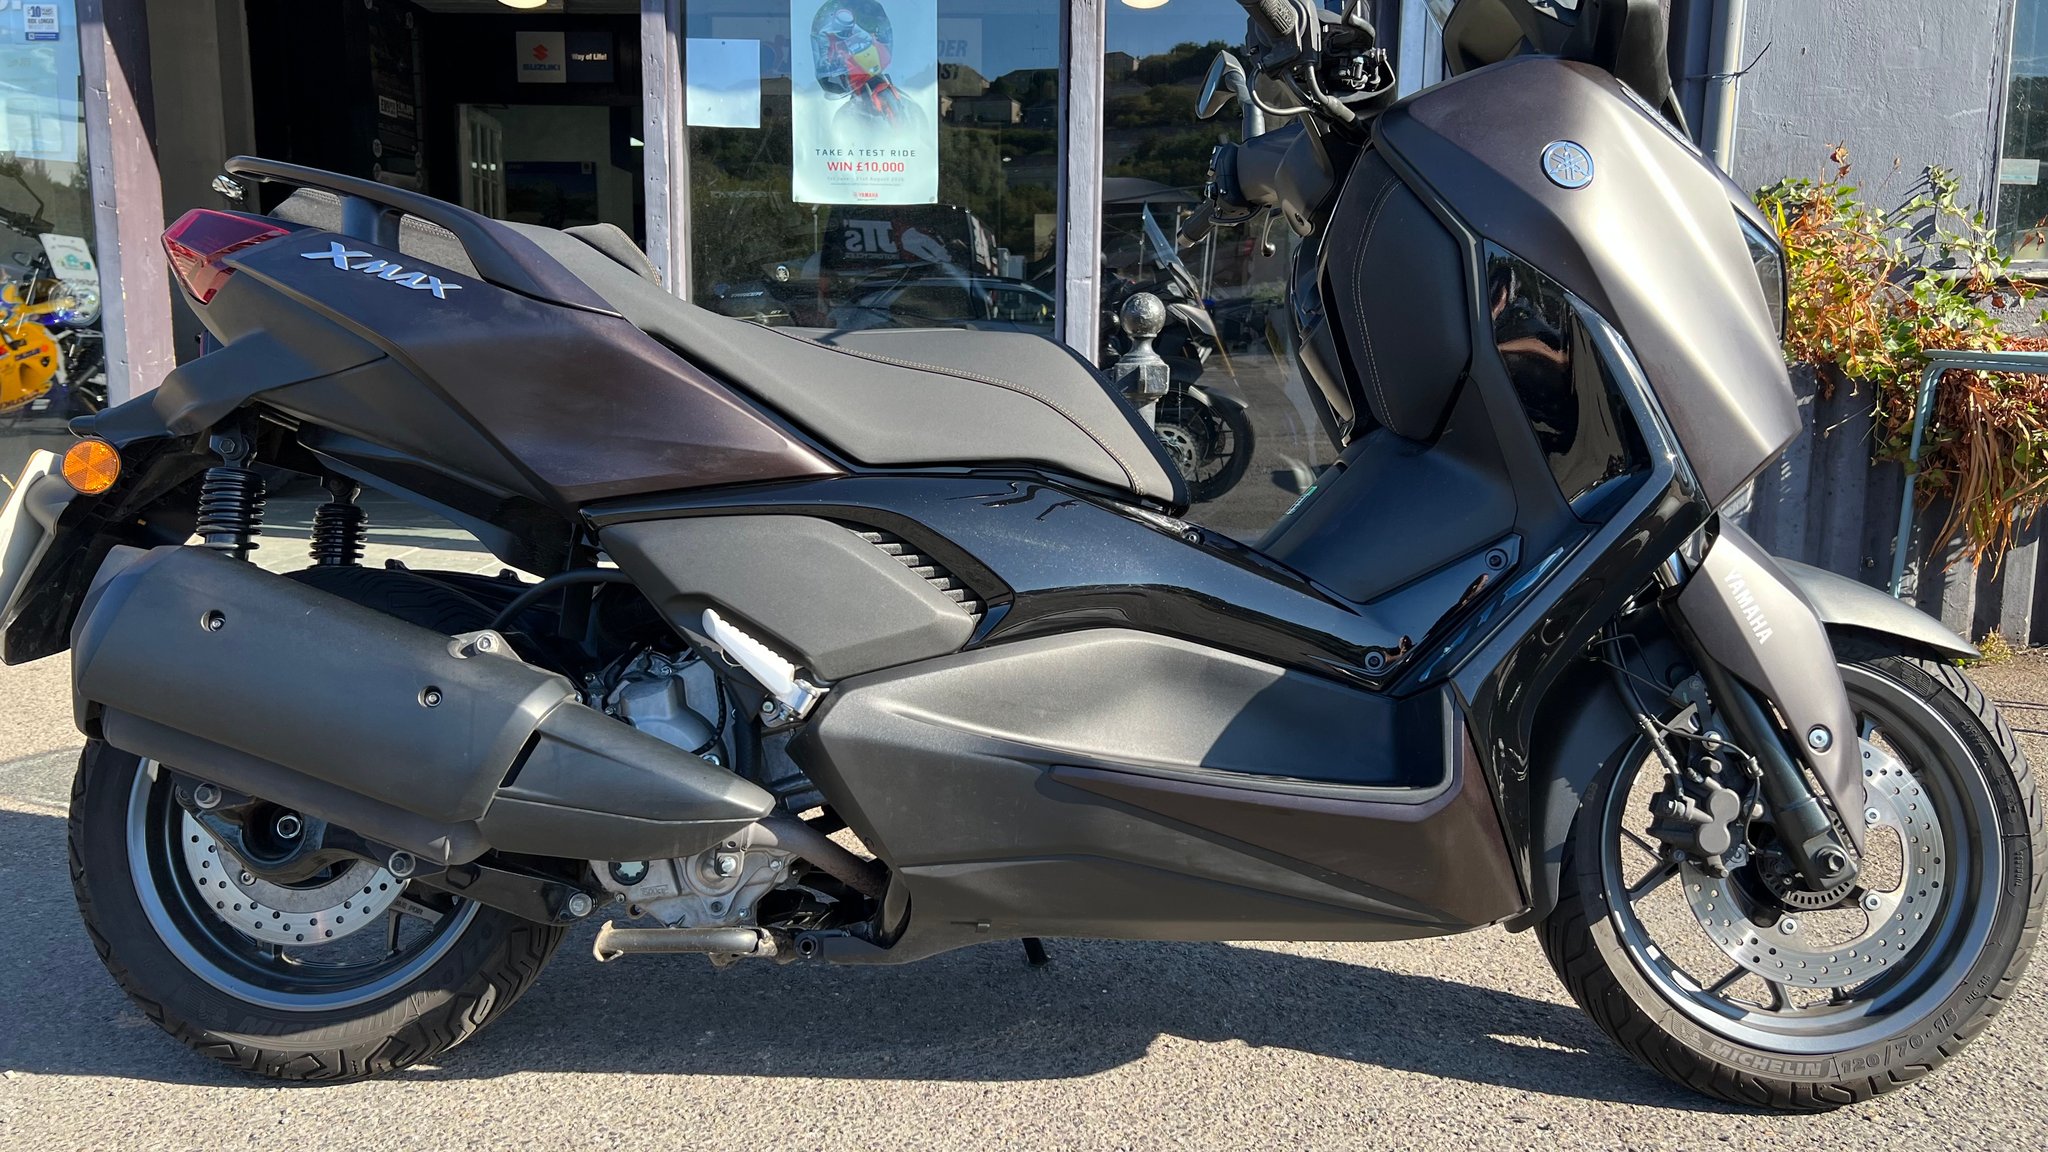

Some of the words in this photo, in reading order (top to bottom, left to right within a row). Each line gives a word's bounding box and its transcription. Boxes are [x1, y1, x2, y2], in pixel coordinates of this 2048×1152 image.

[827, 161, 853, 172] WIN
[856, 161, 905, 173] £10,000
[859, 149, 885, 157] TEST
[301, 241, 463, 300] XMAX
[1724, 567, 1774, 645] YAMAHA
[1708, 1040, 1822, 1076] MICHELIN
